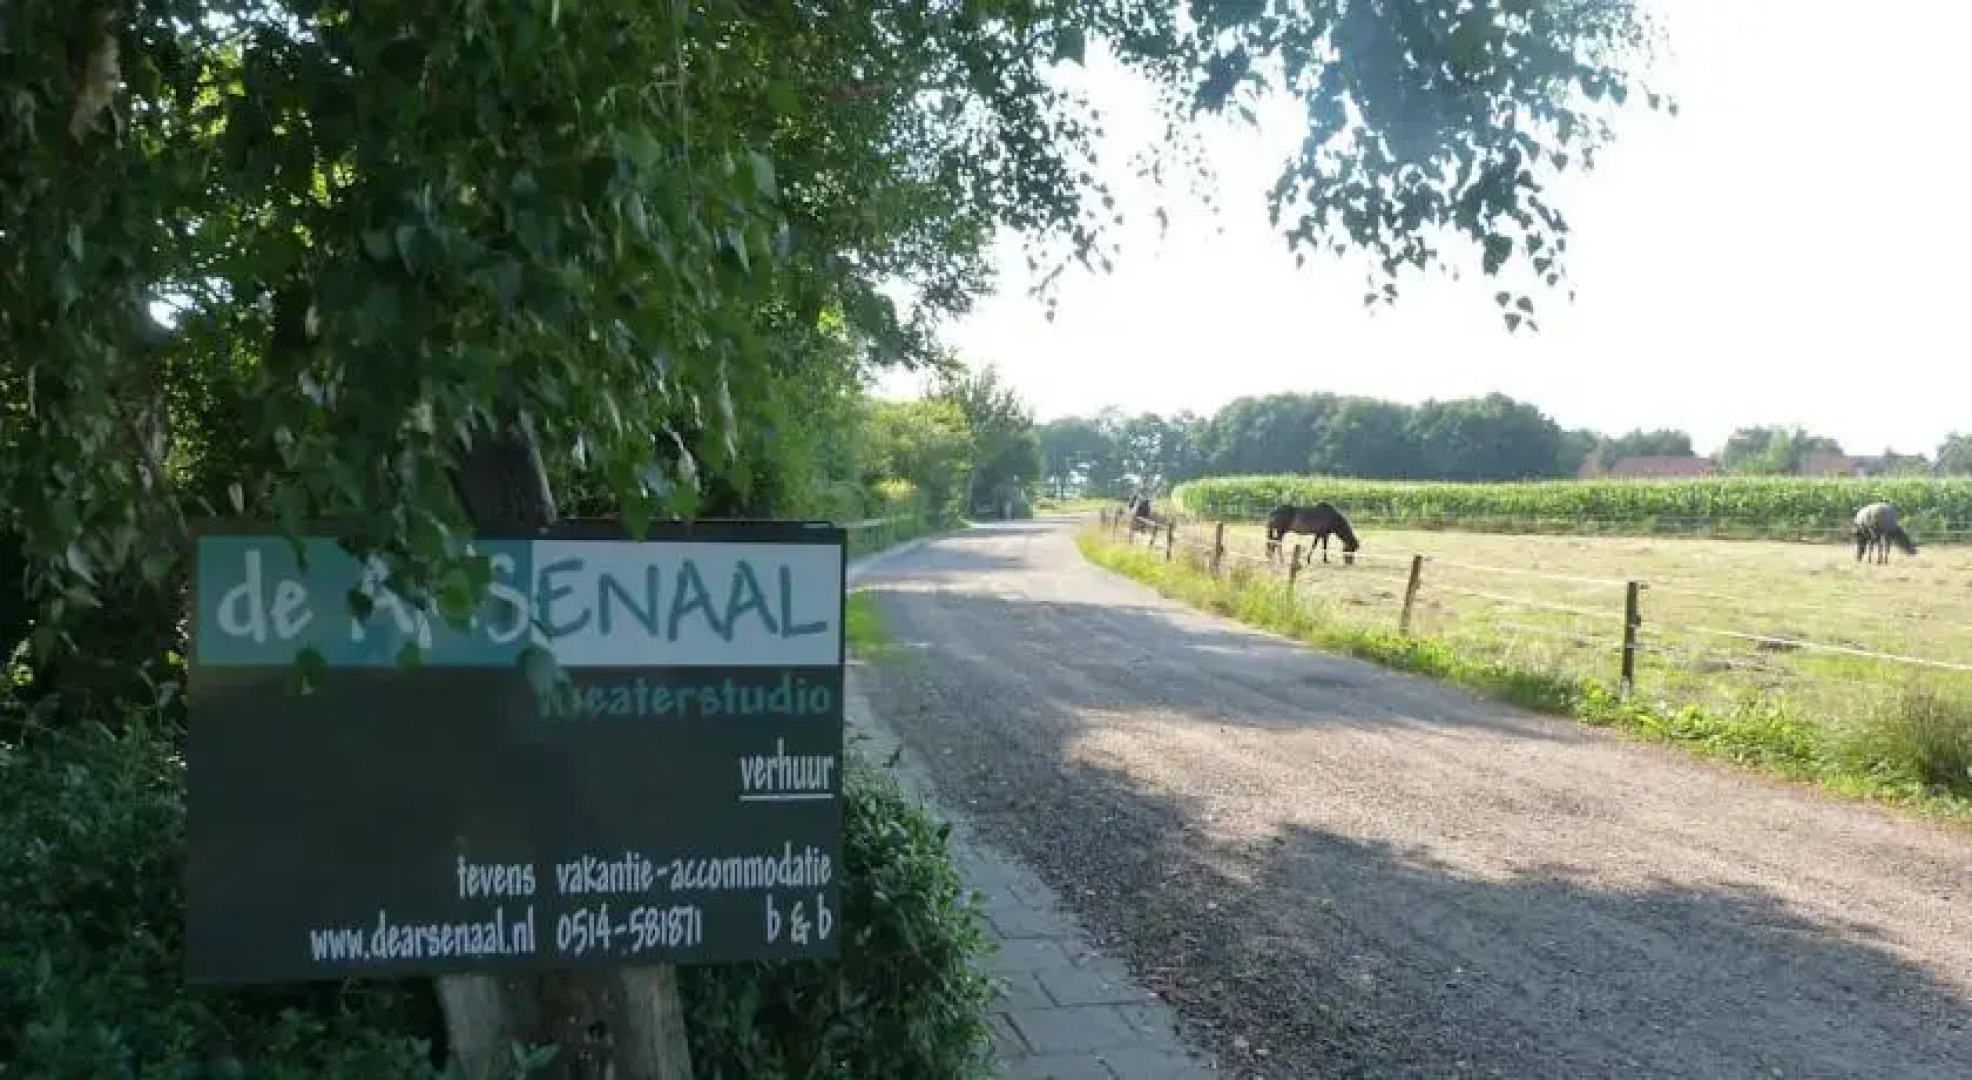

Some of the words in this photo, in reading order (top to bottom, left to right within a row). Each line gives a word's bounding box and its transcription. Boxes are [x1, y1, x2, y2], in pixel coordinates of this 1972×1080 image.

[217, 550, 312, 626] de
[351, 551, 828, 649] ASENAAL
[740, 737, 834, 791] verhuur
[457, 855, 535, 898] tevens
[556, 842, 832, 893] vakantie-accommodatie
[310, 906, 534, 961] www.dearsenaal.nl
[556, 904, 703, 954] 0514-581871
[766, 893, 779, 942] b
[792, 902, 812, 945] &
[817, 892, 832, 941] b
